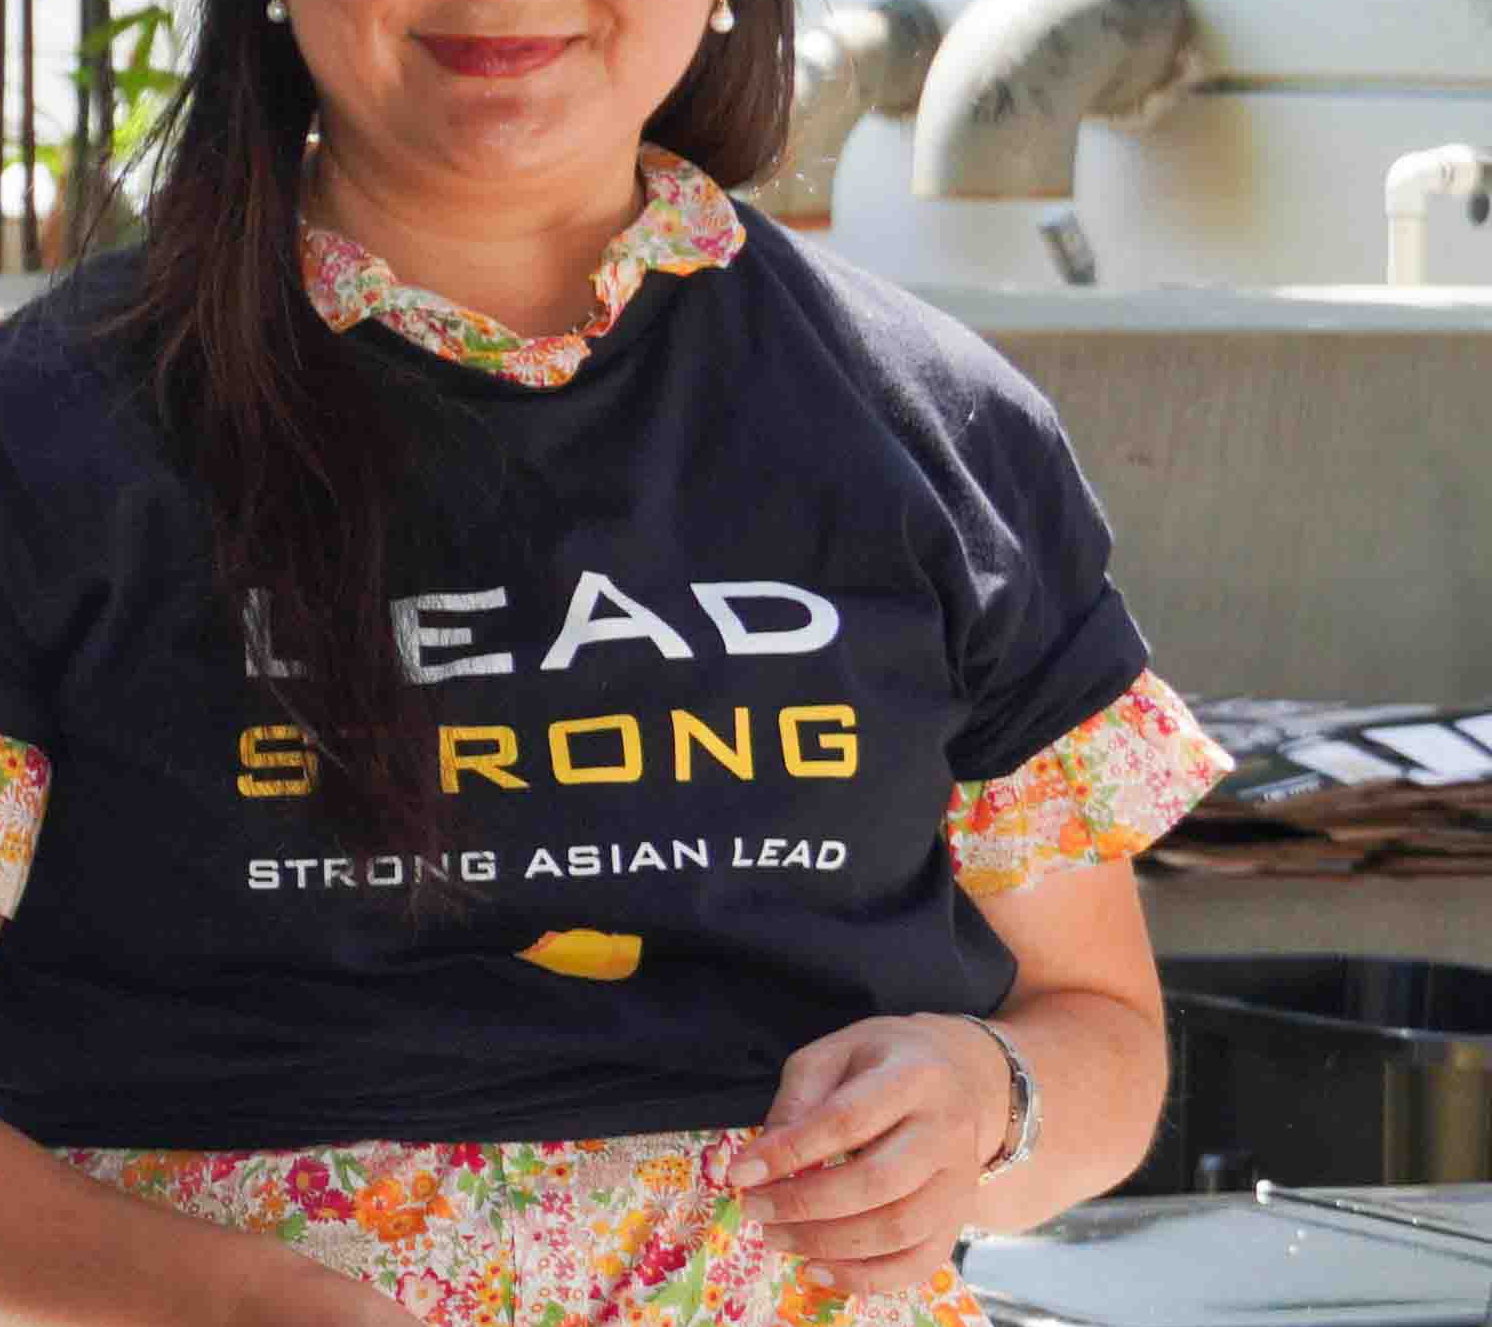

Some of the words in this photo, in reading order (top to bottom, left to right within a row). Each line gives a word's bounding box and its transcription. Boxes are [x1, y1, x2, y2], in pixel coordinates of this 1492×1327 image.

[236, 704, 860, 799] SRONG
[248, 850, 497, 891] STRONG
[525, 837, 710, 880] ASIAN
[731, 836, 848, 873] LEAD
